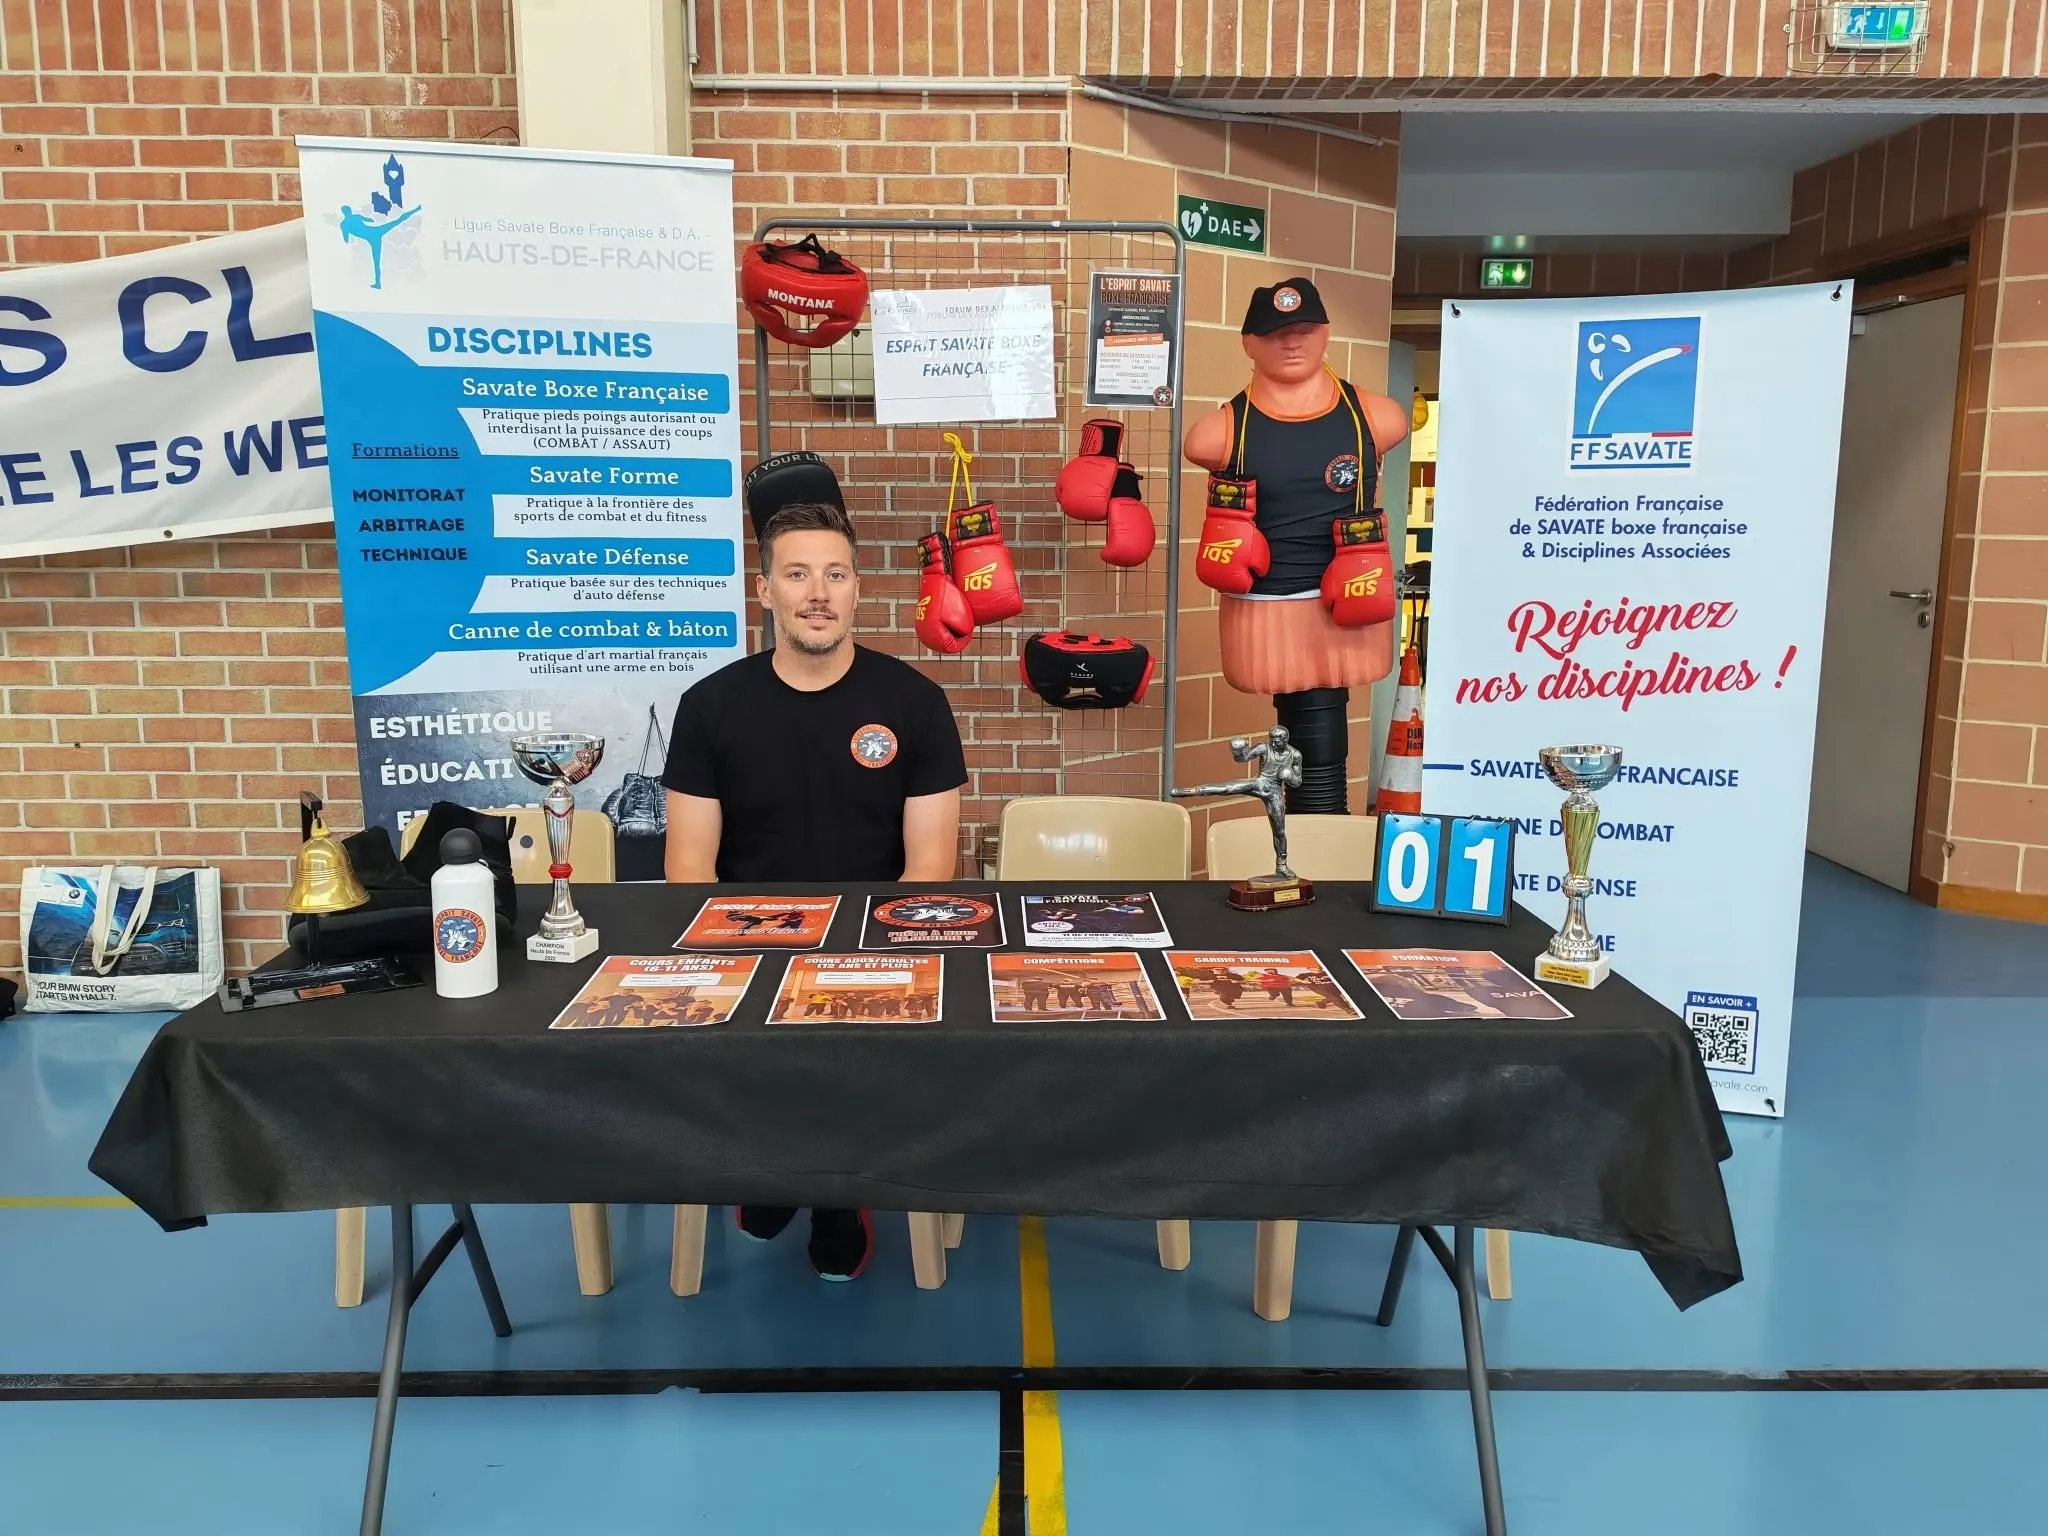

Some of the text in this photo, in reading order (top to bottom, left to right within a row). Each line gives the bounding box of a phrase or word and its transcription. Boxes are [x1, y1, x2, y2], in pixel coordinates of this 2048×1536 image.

[454, 218, 700, 240] Ligue Savate Boxe Française & D.A.
[1208, 216, 1242, 237] DAE
[442, 241, 713, 271] HAUTS-DE-FRANCE
[1101, 278, 1171, 292] L'ESPRIT SAVATE
[768, 287, 834, 309] MONTANA
[1101, 291, 1170, 306] BOXE FRANÇAISE
[428, 327, 651, 358] DISCIPLINES
[886, 339, 936, 353] ESPRIT
[940, 336, 995, 351] SAVATE
[463, 378, 709, 404] Savate Boxe Française
[483, 410, 716, 427] Pratique pieds poings autorisant ou
[488, 422, 712, 439] interdisant la puissance des coups
[353, 443, 459, 458] Formations
[533, 437, 670, 451] (COMBAT / ASSAUT)
[0, 452, 54, 506] E
[70, 436, 202, 498] LES
[761, 454, 801, 471] YOUR
[530, 467, 679, 484] Savate Forme
[353, 488, 465, 502] MONITORAT
[527, 498, 694, 511] Pratique à la frontière des
[1534, 495, 1724, 515] Fédération Française
[359, 518, 464, 532] ARBITRAGE
[514, 511, 707, 524] sports de combat et du fitness
[1509, 519, 1747, 539] de SAVATE boxe française
[361, 548, 467, 562] TECHNIQUE
[526, 547, 689, 566] Savate Défense
[1522, 542, 1731, 561] & Disciplines Associées
[511, 577, 727, 591] Pratique basée sur des techniques
[573, 590, 665, 601] d'auto défense
[448, 619, 728, 641] Canne de combat & bâton
[1507, 597, 1738, 660] Rejoignez
[518, 650, 708, 663] Pratique d'art martial français
[529, 661, 694, 674] utilisant une arme en bois
[1456, 645, 1797, 712] nos disciplines !
[370, 707, 552, 739] ESTHÉTIQUE
[380, 758, 526, 785] ÉDUCATI
[1470, 759, 1739, 788] SAVATE FRANCAISE
[1594, 821, 1674, 842] OMBAT
[1388, 831, 1494, 911] 0 1
[1023, 956, 1105, 965] COMPÉTITIONS
[1194, 956, 1290, 964] CARDIO TRAINING
[1392, 954, 1458, 963] FORMATION
[37, 982, 116, 993] YOUR BMW STORY
[1692, 995, 1705, 1003] EN
[1708, 996, 1742, 1007] SAVOIR
